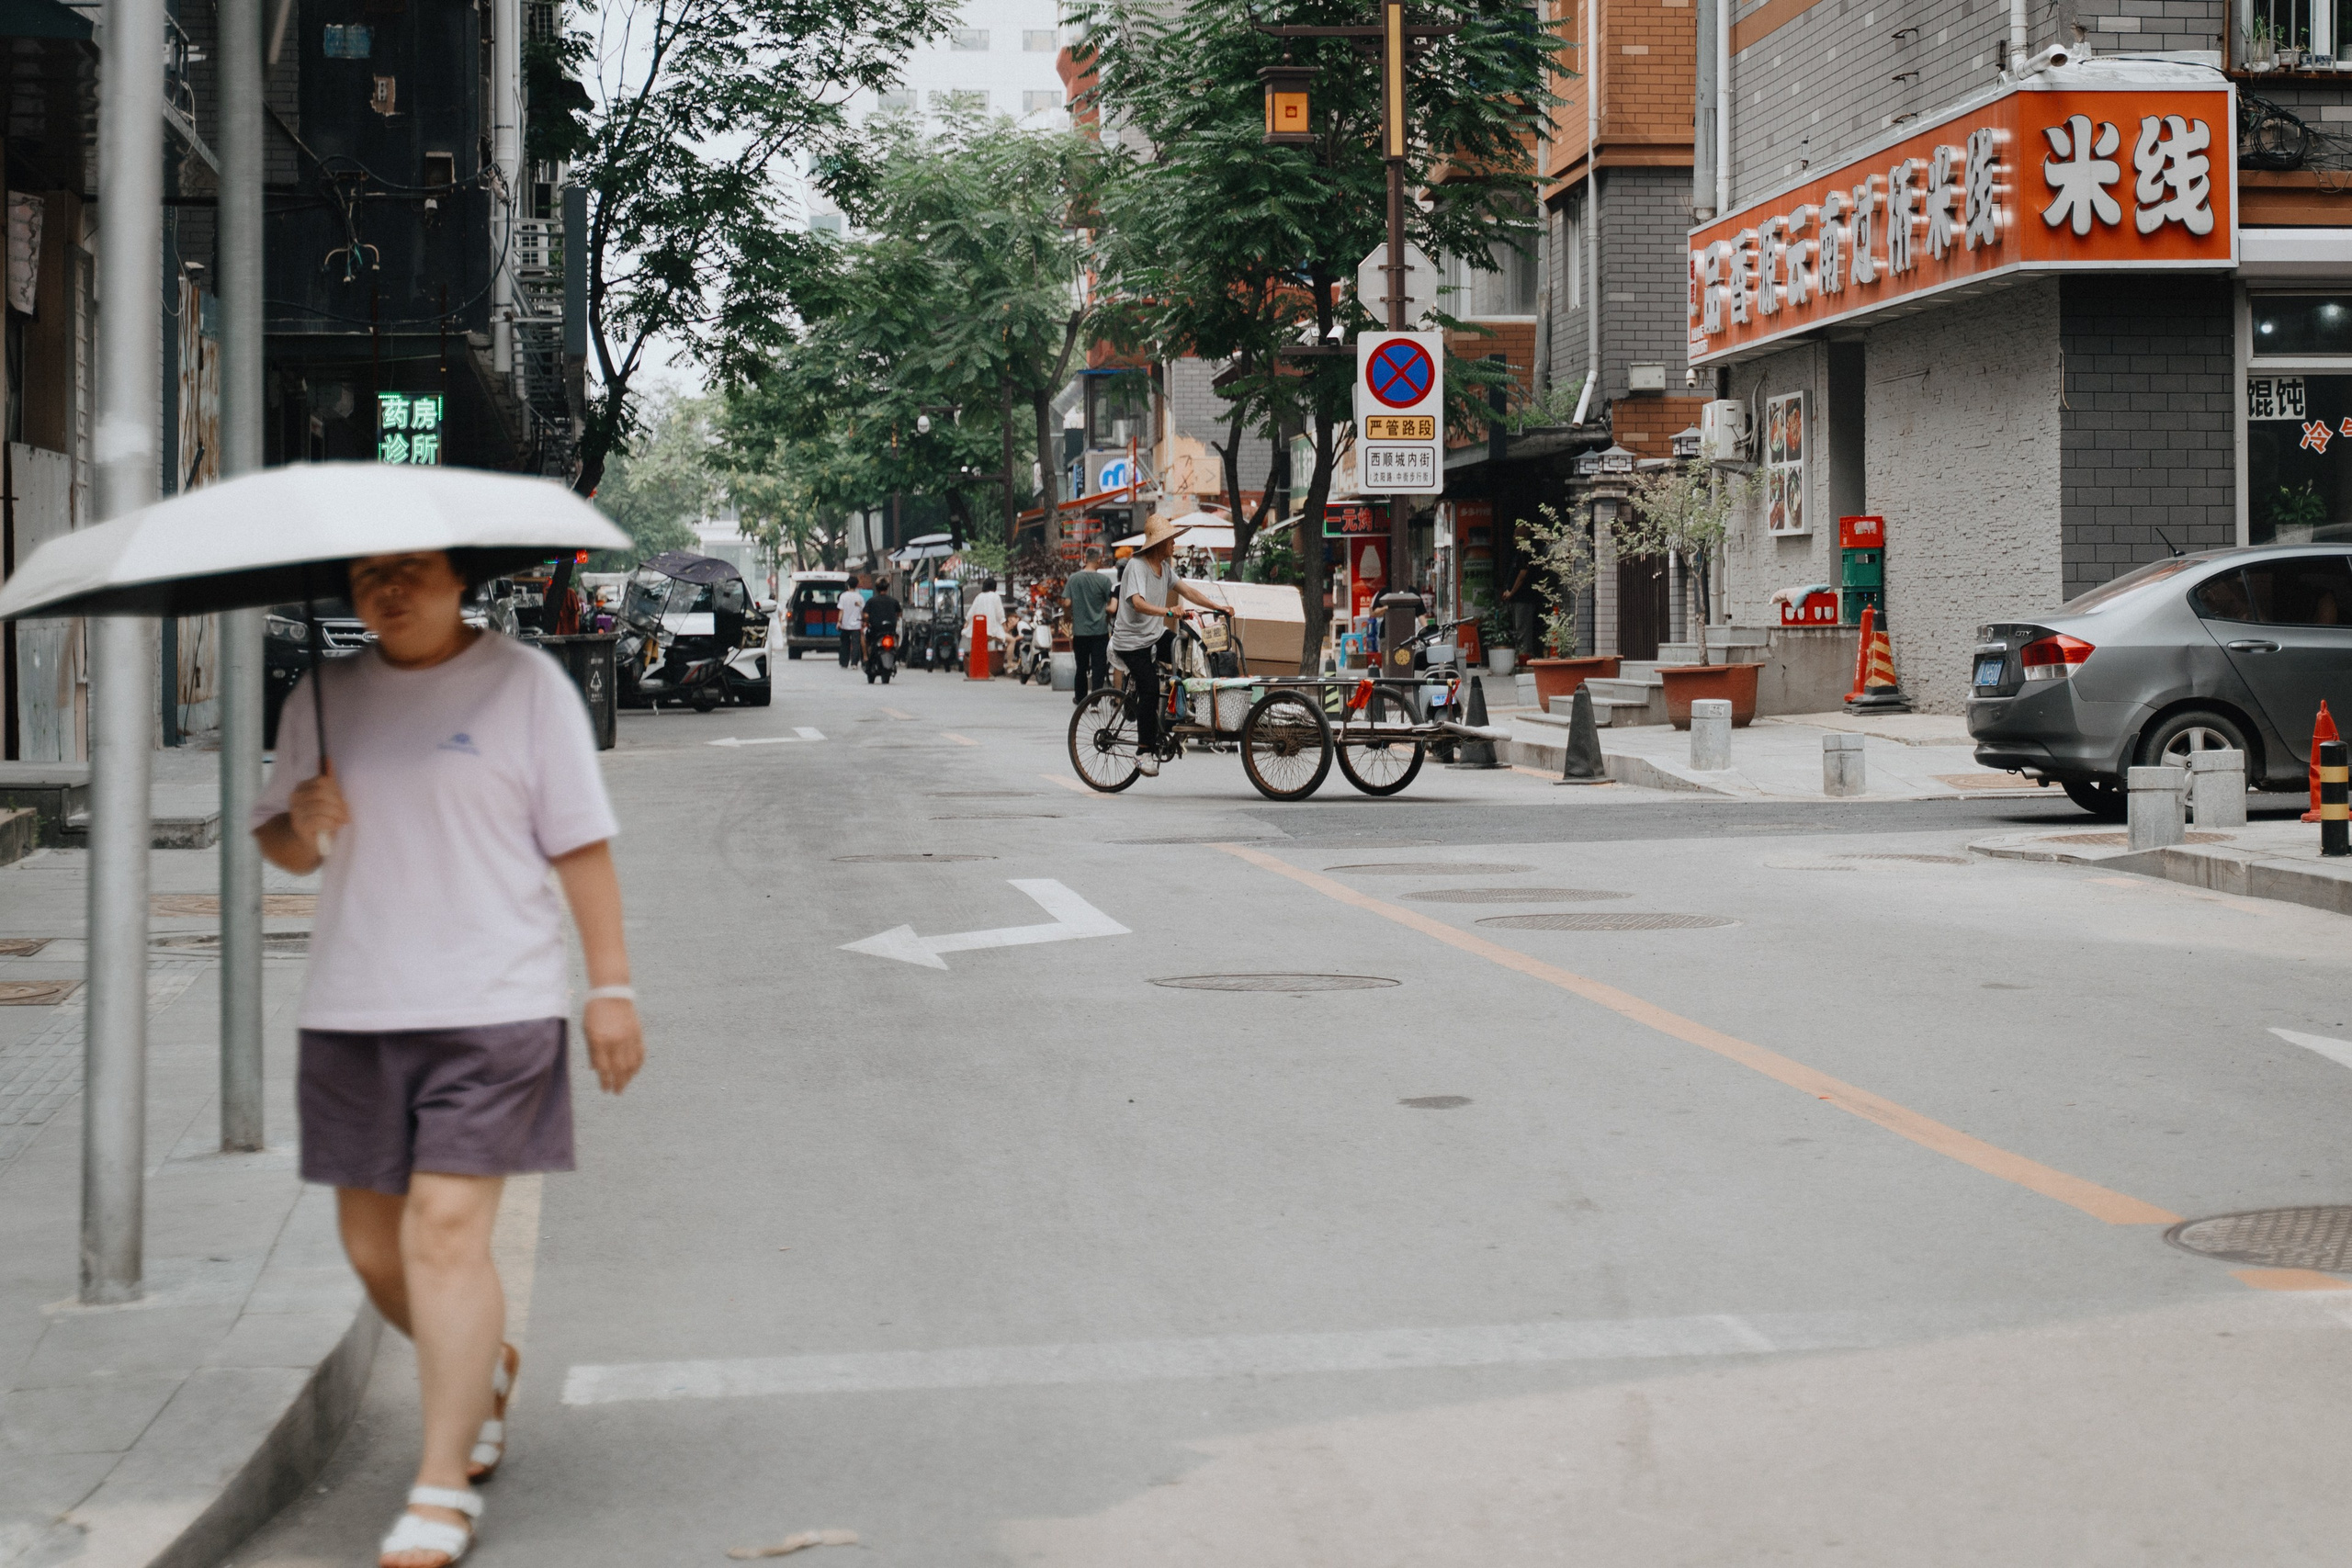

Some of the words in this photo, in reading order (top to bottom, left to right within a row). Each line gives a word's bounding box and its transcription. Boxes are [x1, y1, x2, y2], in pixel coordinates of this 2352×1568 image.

[2041, 114, 2214, 236] 米线
[1703, 128, 1997, 334] 品香源云南过桥米线
[381, 398, 437, 430] 药房
[2247, 378, 2304, 418] 馄饨
[1370, 420, 1431, 436] 严管路段
[381, 433, 438, 466] 诊所
[1371, 452, 1430, 468] 西顺城内街
